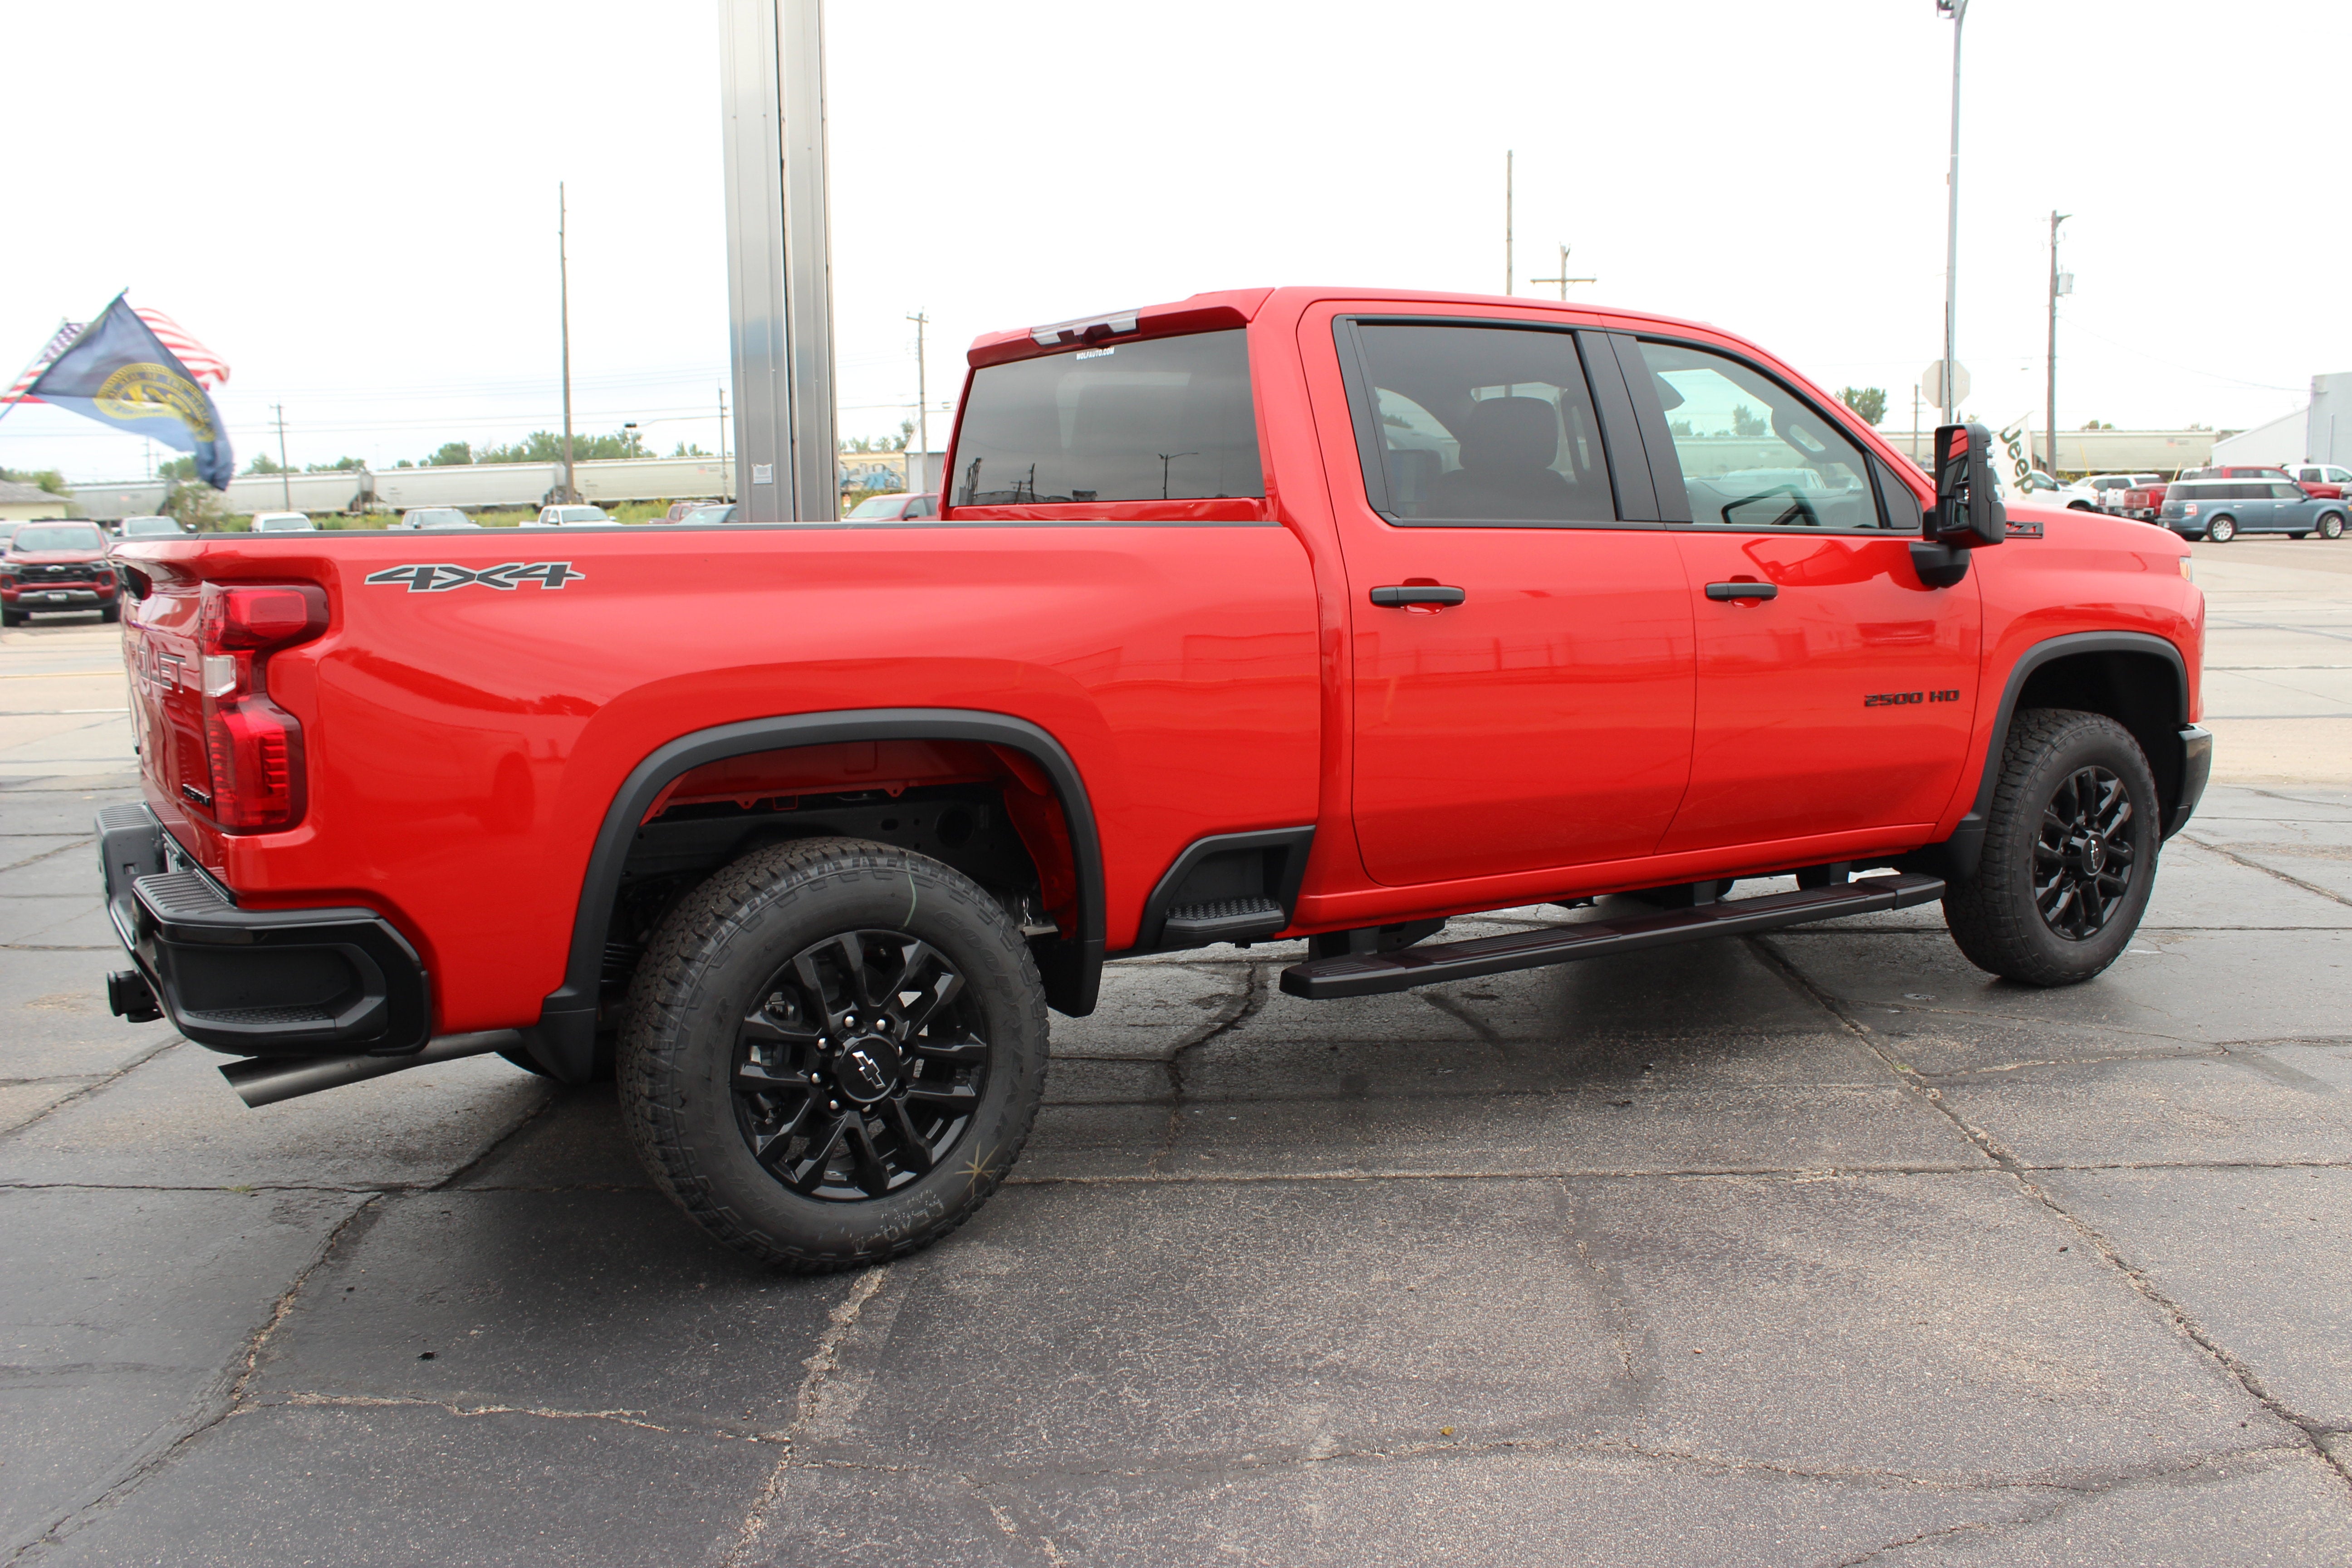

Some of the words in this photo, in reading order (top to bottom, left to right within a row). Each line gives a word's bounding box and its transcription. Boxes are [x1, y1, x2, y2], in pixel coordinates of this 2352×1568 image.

[1076, 347, 1115, 360] WOLFAUTO.COM
[1999, 426, 2034, 495] Jeep
[1864, 691, 1924, 707] 2500
[1930, 689, 1960, 702] HD
[934, 911, 1024, 1140] GOODYEAR
[700, 996, 795, 1230] WRANGLER
